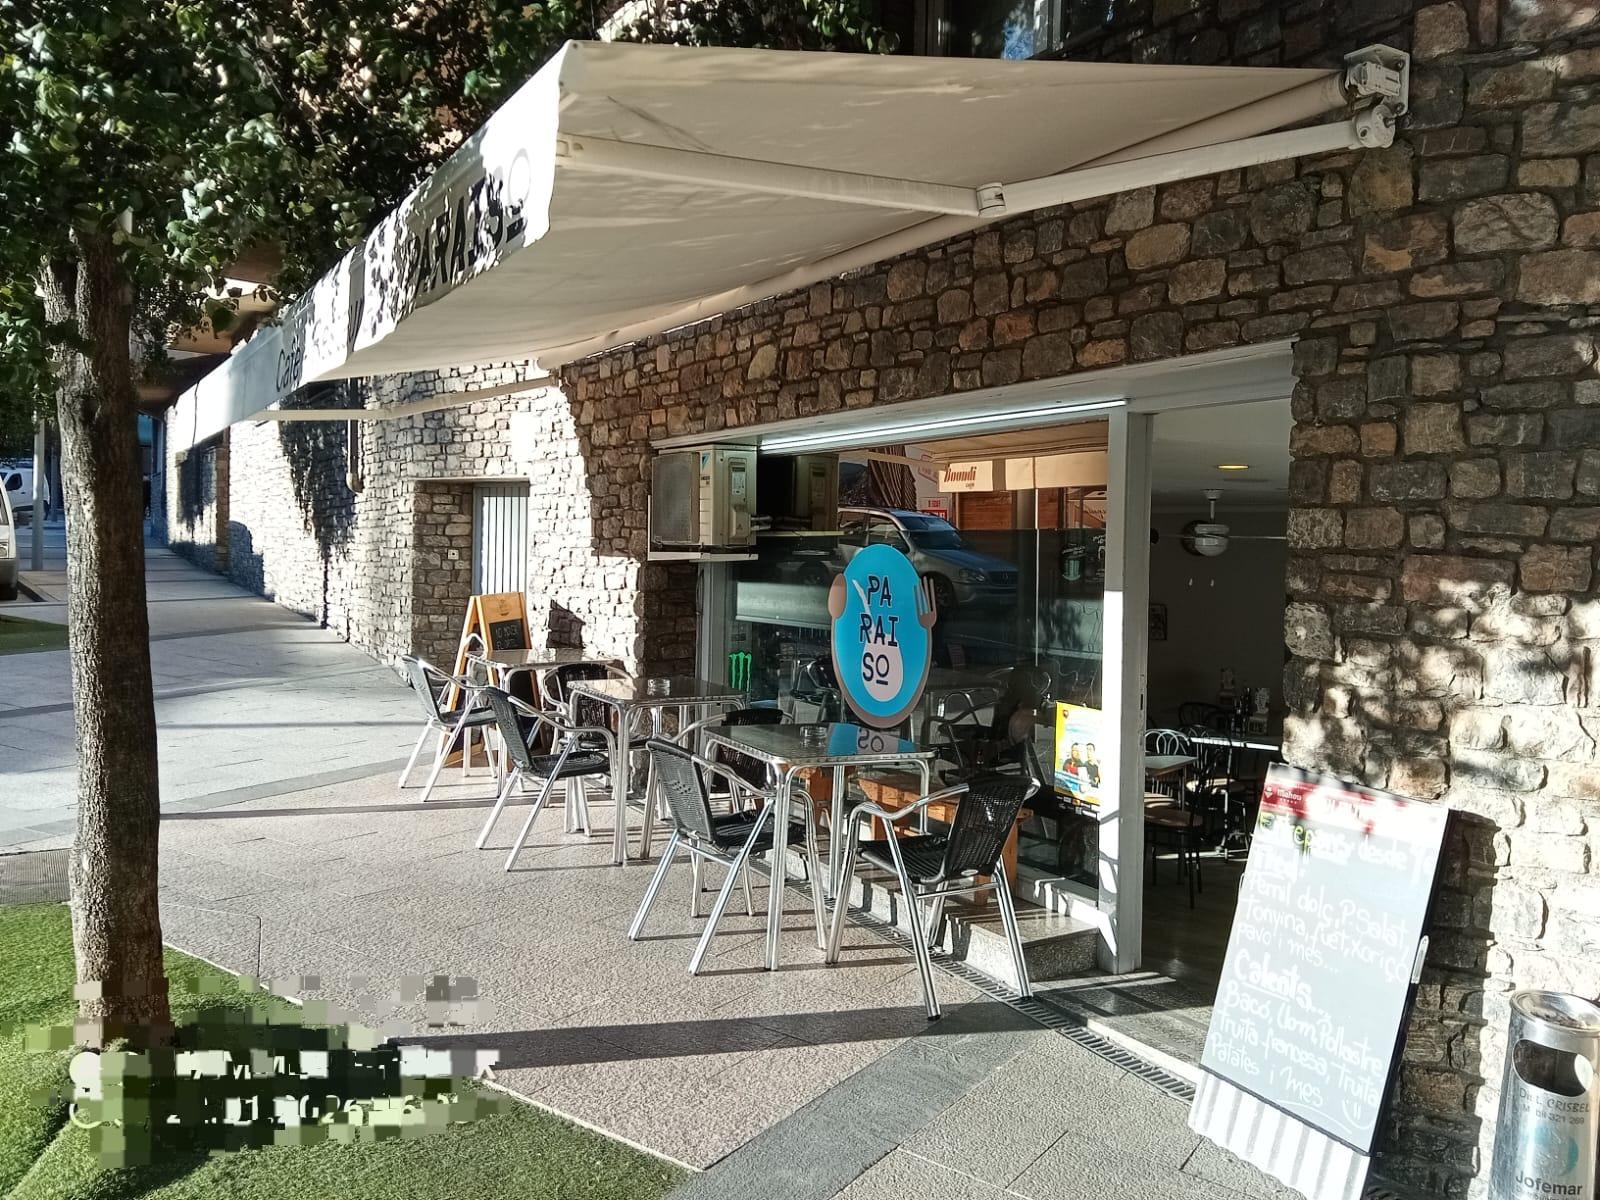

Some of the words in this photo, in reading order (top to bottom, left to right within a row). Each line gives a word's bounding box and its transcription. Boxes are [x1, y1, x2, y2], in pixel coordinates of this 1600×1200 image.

[867, 575, 892, 607] PA
[860, 613, 901, 648] RAI
[862, 651, 890, 686] SO
[1515, 1170, 1583, 1196] Jofemar
